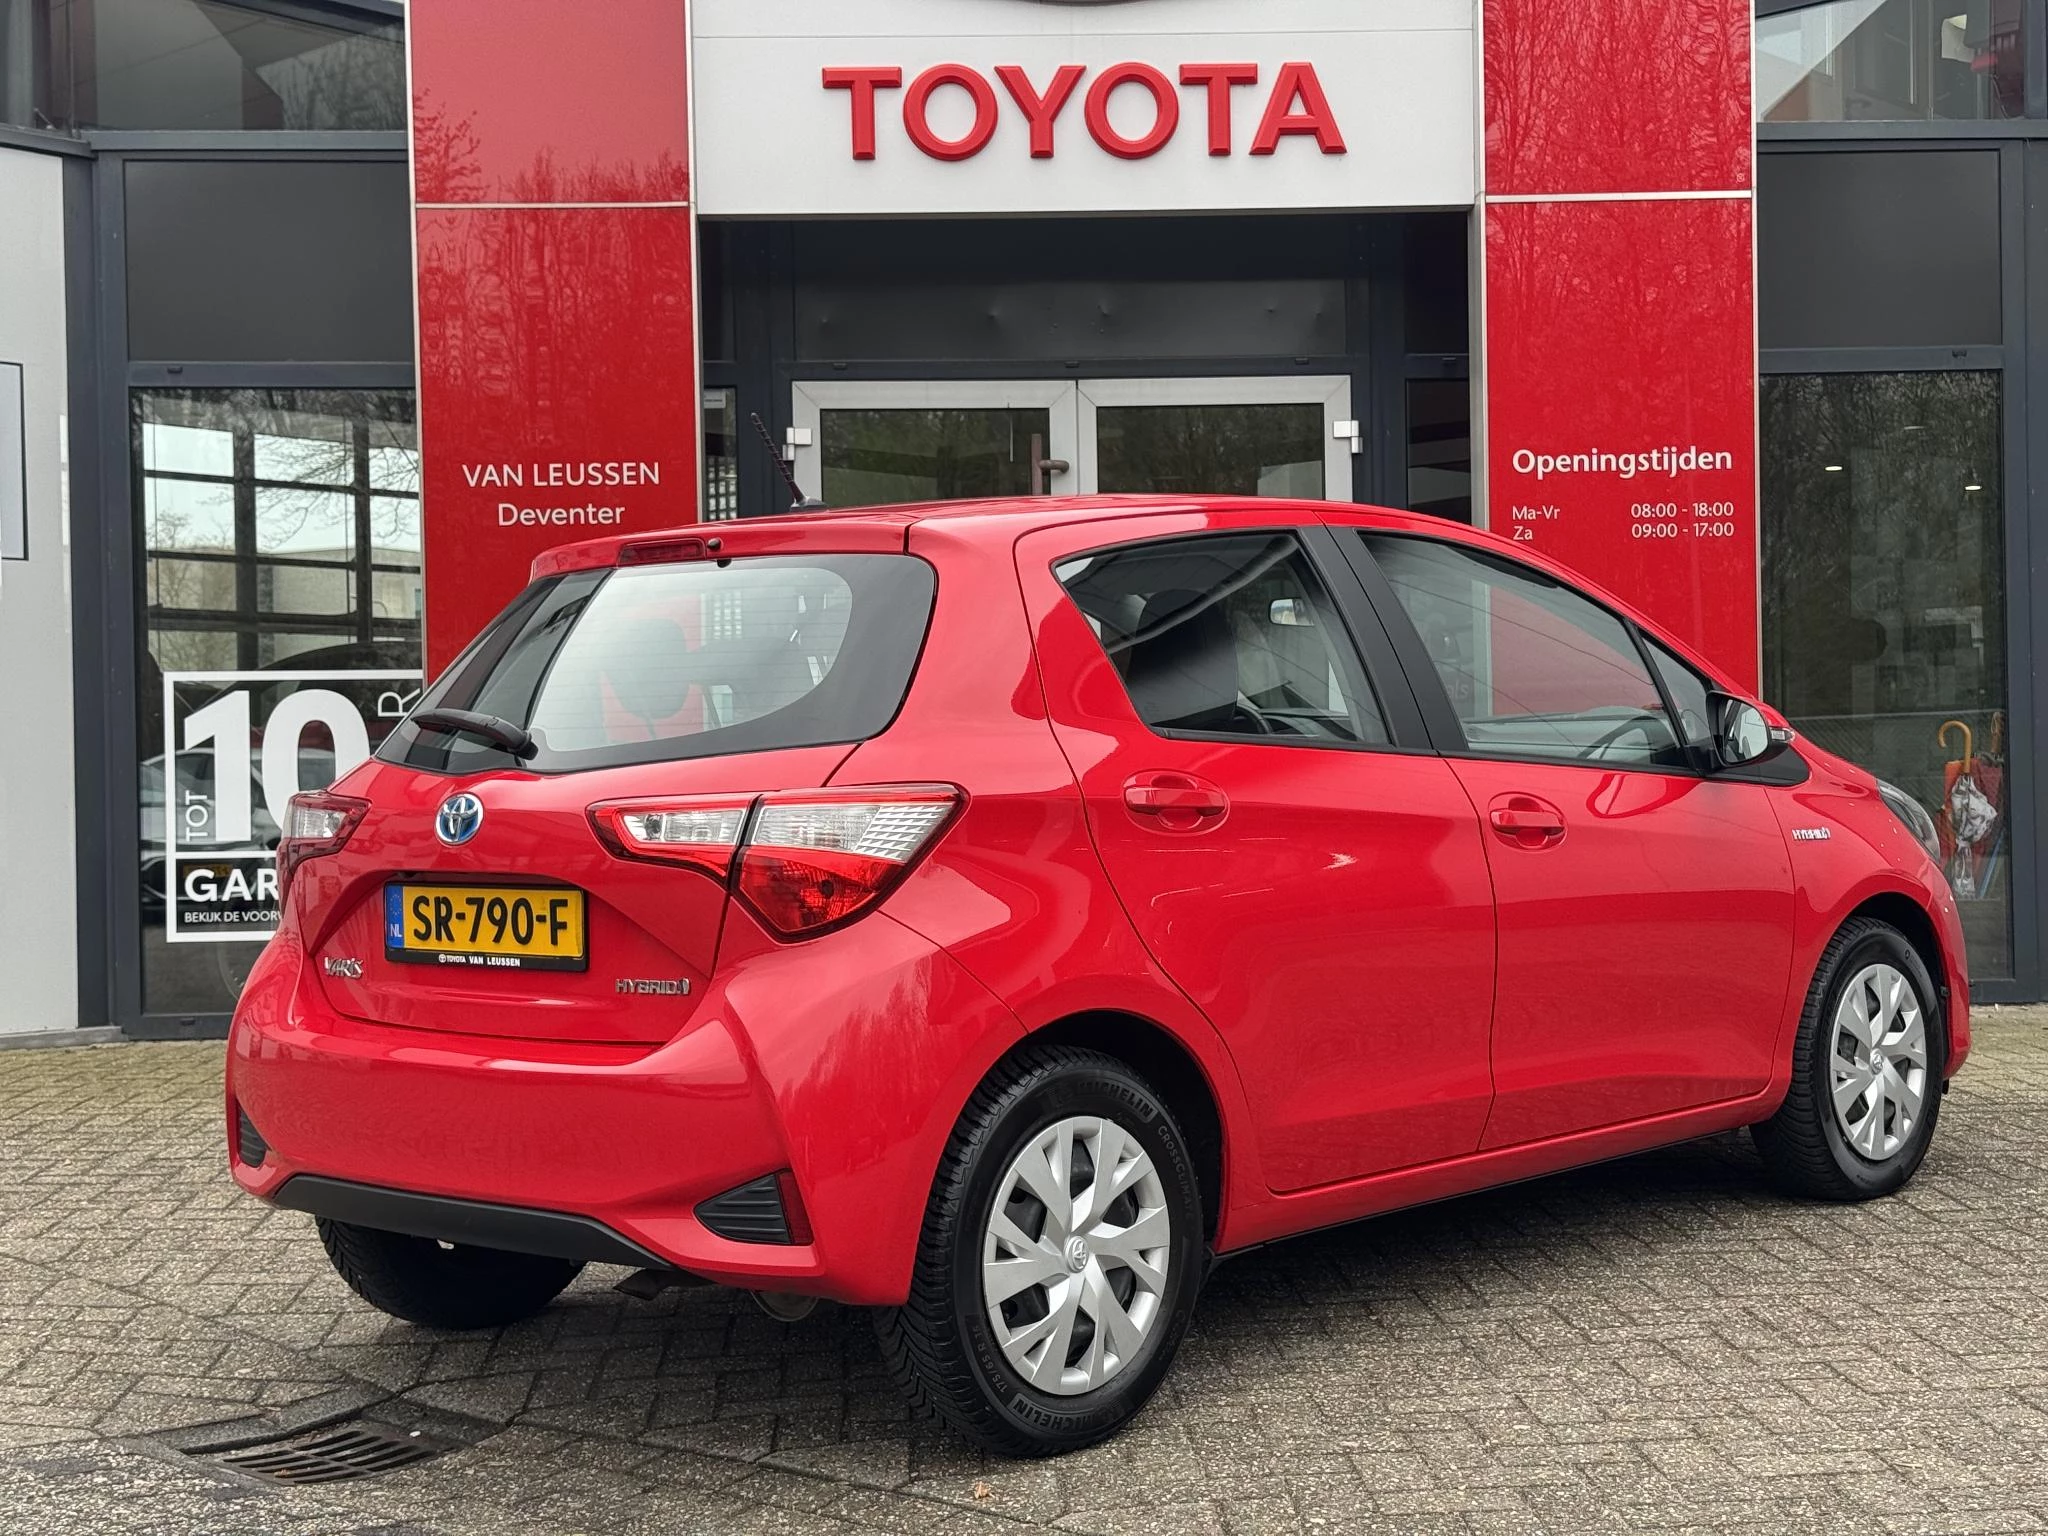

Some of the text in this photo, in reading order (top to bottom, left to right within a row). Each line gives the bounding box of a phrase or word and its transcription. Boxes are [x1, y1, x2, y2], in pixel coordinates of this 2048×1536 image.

[822, 62, 1347, 160] TOYOTA
[462, 462, 660, 487] VAN LEUSSEN
[1512, 446, 1732, 480] Openingstijden
[498, 503, 625, 526] Deventer
[1512, 505, 1560, 520] Ma-Vr
[1631, 503, 1677, 518] 08:00
[1692, 501, 1734, 517] 18:00
[1513, 525, 1533, 540] Za
[1631, 523, 1677, 538] 09:00
[1693, 522, 1735, 536] 17:00
[184, 689, 370, 842] 10
[186, 790, 208, 842] TOT
[184, 911, 222, 922] BEKIJK
[224, 911, 240, 921] DE
[412, 895, 568, 946] SR-790-F
[390, 924, 402, 937] NL
[469, 956, 484, 965] VAN
[487, 957, 521, 967] LEUSSEN
[615, 978, 678, 995] HYBRID
